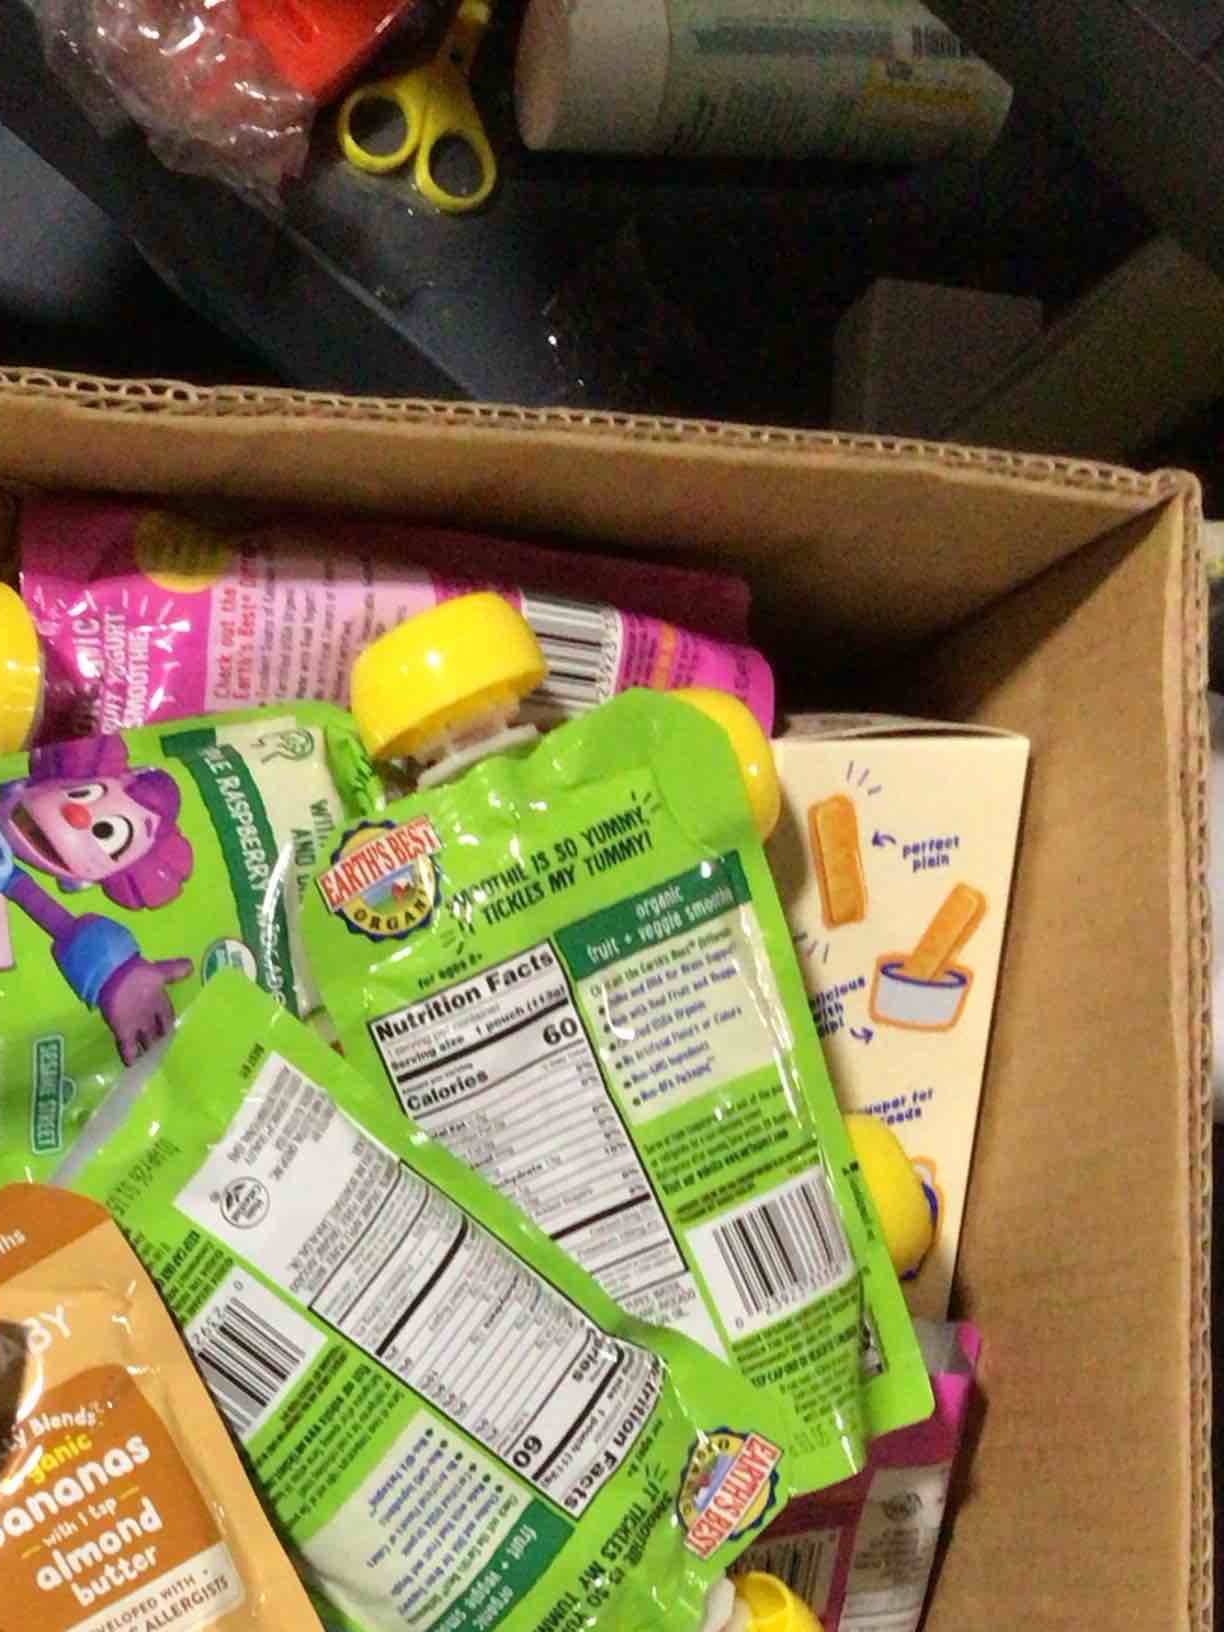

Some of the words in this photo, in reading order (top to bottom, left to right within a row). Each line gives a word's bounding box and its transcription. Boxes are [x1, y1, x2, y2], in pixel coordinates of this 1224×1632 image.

[220, 585, 236, 613] the
[219, 620, 232, 647] out
[213, 654, 231, 698] Check
[212, 772, 277, 895] RASPBERRY
[530, 850, 552, 873] IS
[553, 836, 579, 862] SO
[578, 806, 651, 851] YUMMY,
[901, 832, 961, 861] perfect
[317, 843, 395, 906] EARTH'S
[389, 818, 441, 863] BEST
[479, 879, 547, 926] TICKLES
[546, 864, 579, 892] MY
[581, 830, 655, 875] TUMMY!
[911, 848, 951, 874] plain
[632, 883, 685, 918] organic
[584, 935, 620, 962] fruit
[635, 911, 684, 943] veggie
[372, 983, 485, 1042] Nutrition
[484, 948, 557, 994] Facts
[390, 1044, 438, 1073] Serving
[438, 1033, 466, 1053] size
[483, 1005, 526, 1034] pouch
[403, 1065, 490, 1113] Calories
[539, 1014, 581, 1048] 60
[509, 1431, 545, 1471] 60
[568, 1413, 602, 1455] pouch
[562, 1447, 617, 1513] Facts
[640, 1479, 662, 1500] IT
[709, 1434, 780, 1518] EARTH'S
[29, 1499, 167, 1594] almond
[40, 1514, 85, 1551] with
[504, 1523, 537, 1560] fruit
[597, 1500, 647, 1562] TICKLES
[681, 1506, 731, 1560] BEST
[67, 1540, 164, 1610] butter
[158, 1572, 198, 1605] WITH
[462, 1568, 502, 1611] veggie
[576, 1559, 606, 1591] MY
[470, 1583, 516, 1632] organic
